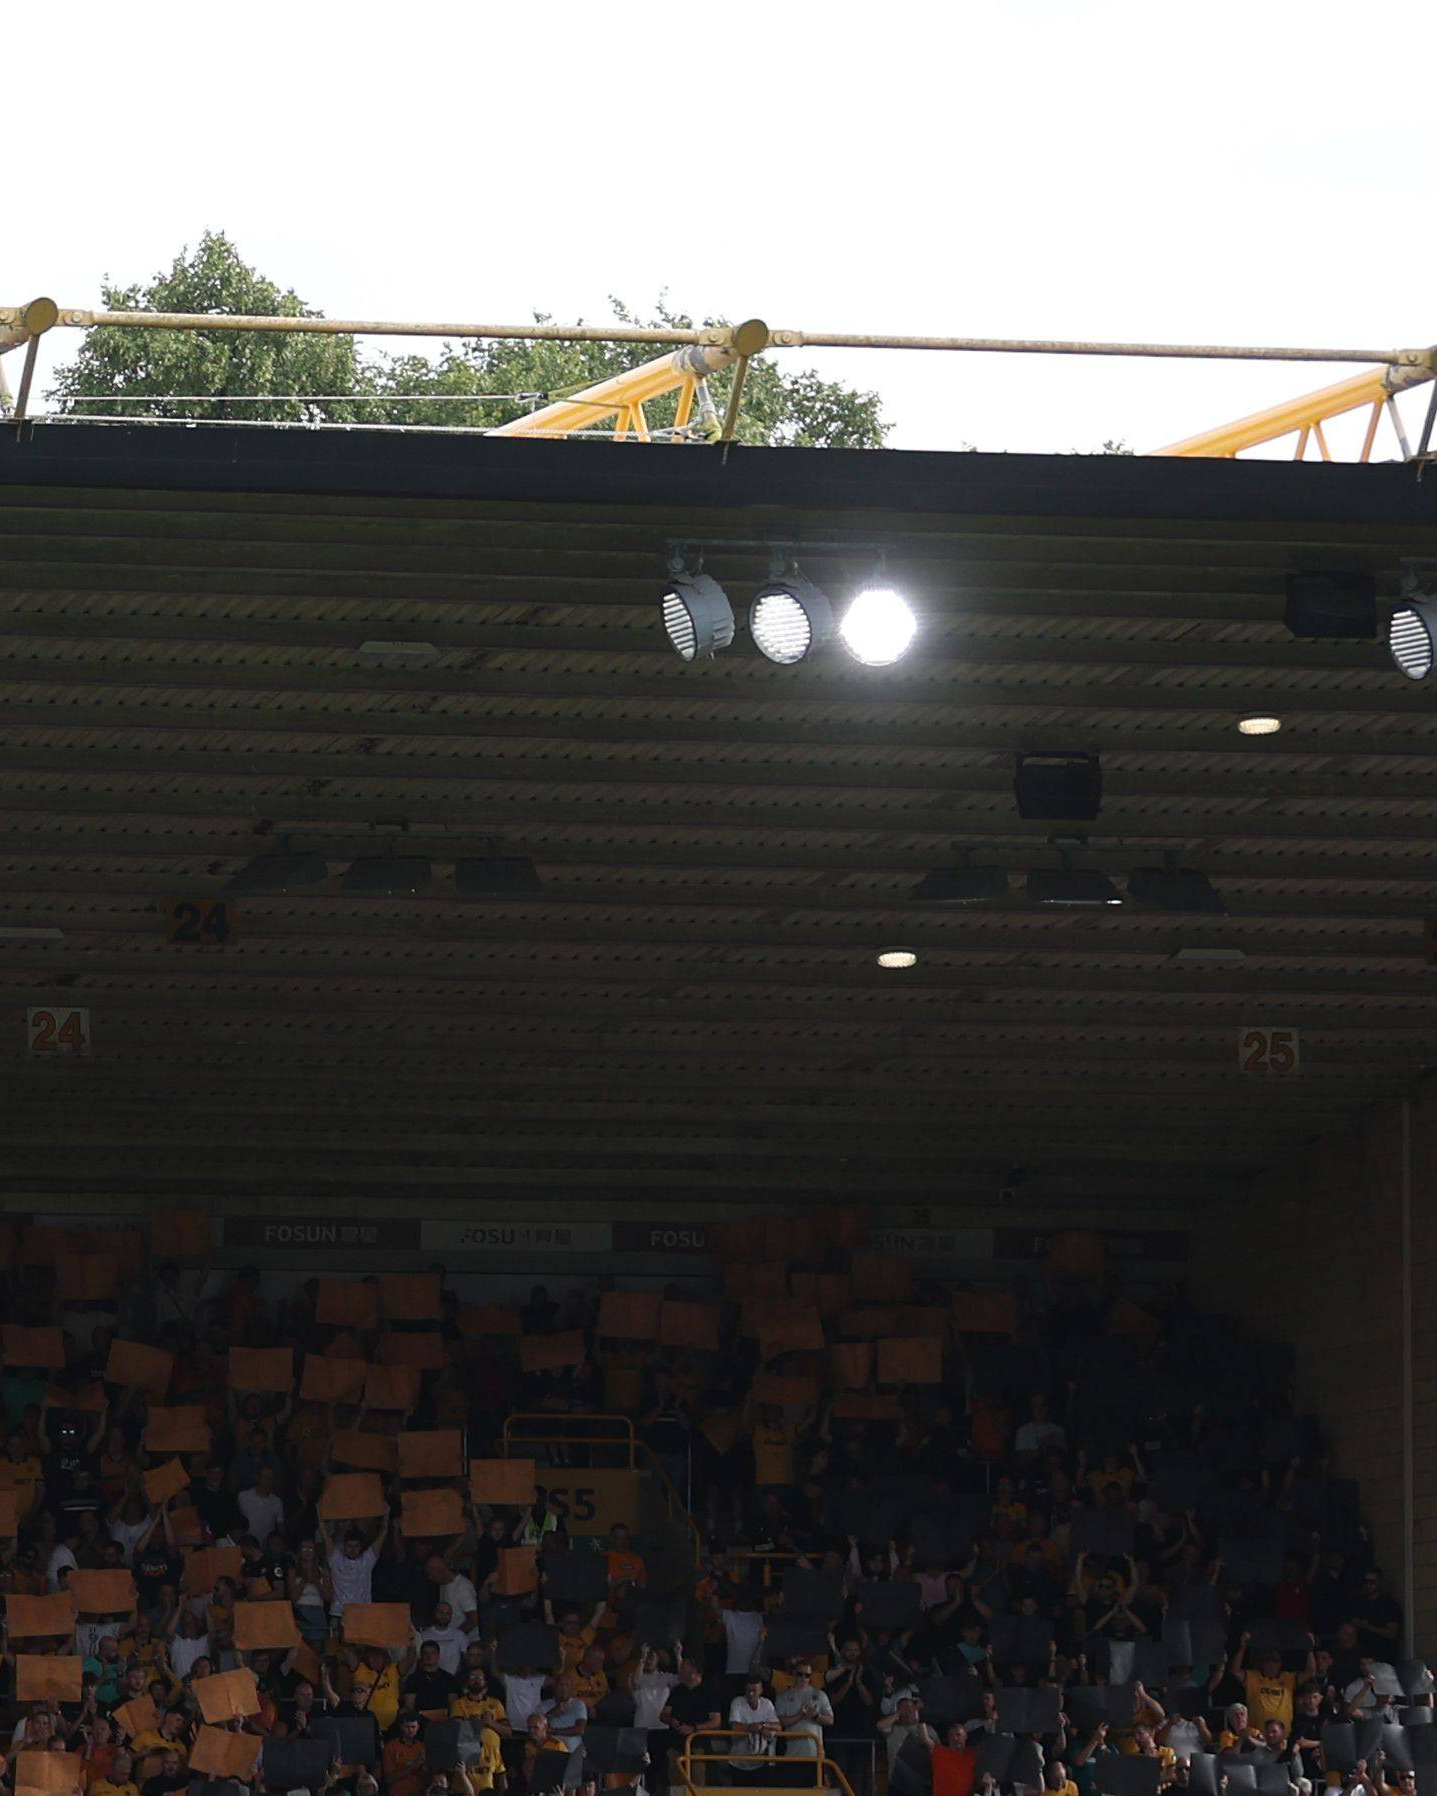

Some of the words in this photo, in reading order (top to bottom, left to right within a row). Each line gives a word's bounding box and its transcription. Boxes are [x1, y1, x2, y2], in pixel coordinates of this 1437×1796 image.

[174, 901, 231, 942] 24
[32, 1010, 85, 1052] 24
[1243, 1032, 1295, 1070] 25
[265, 1226, 337, 1242] FOSUN
[650, 1230, 706, 1247] FOSU
[558, 1487, 597, 1522] S5
